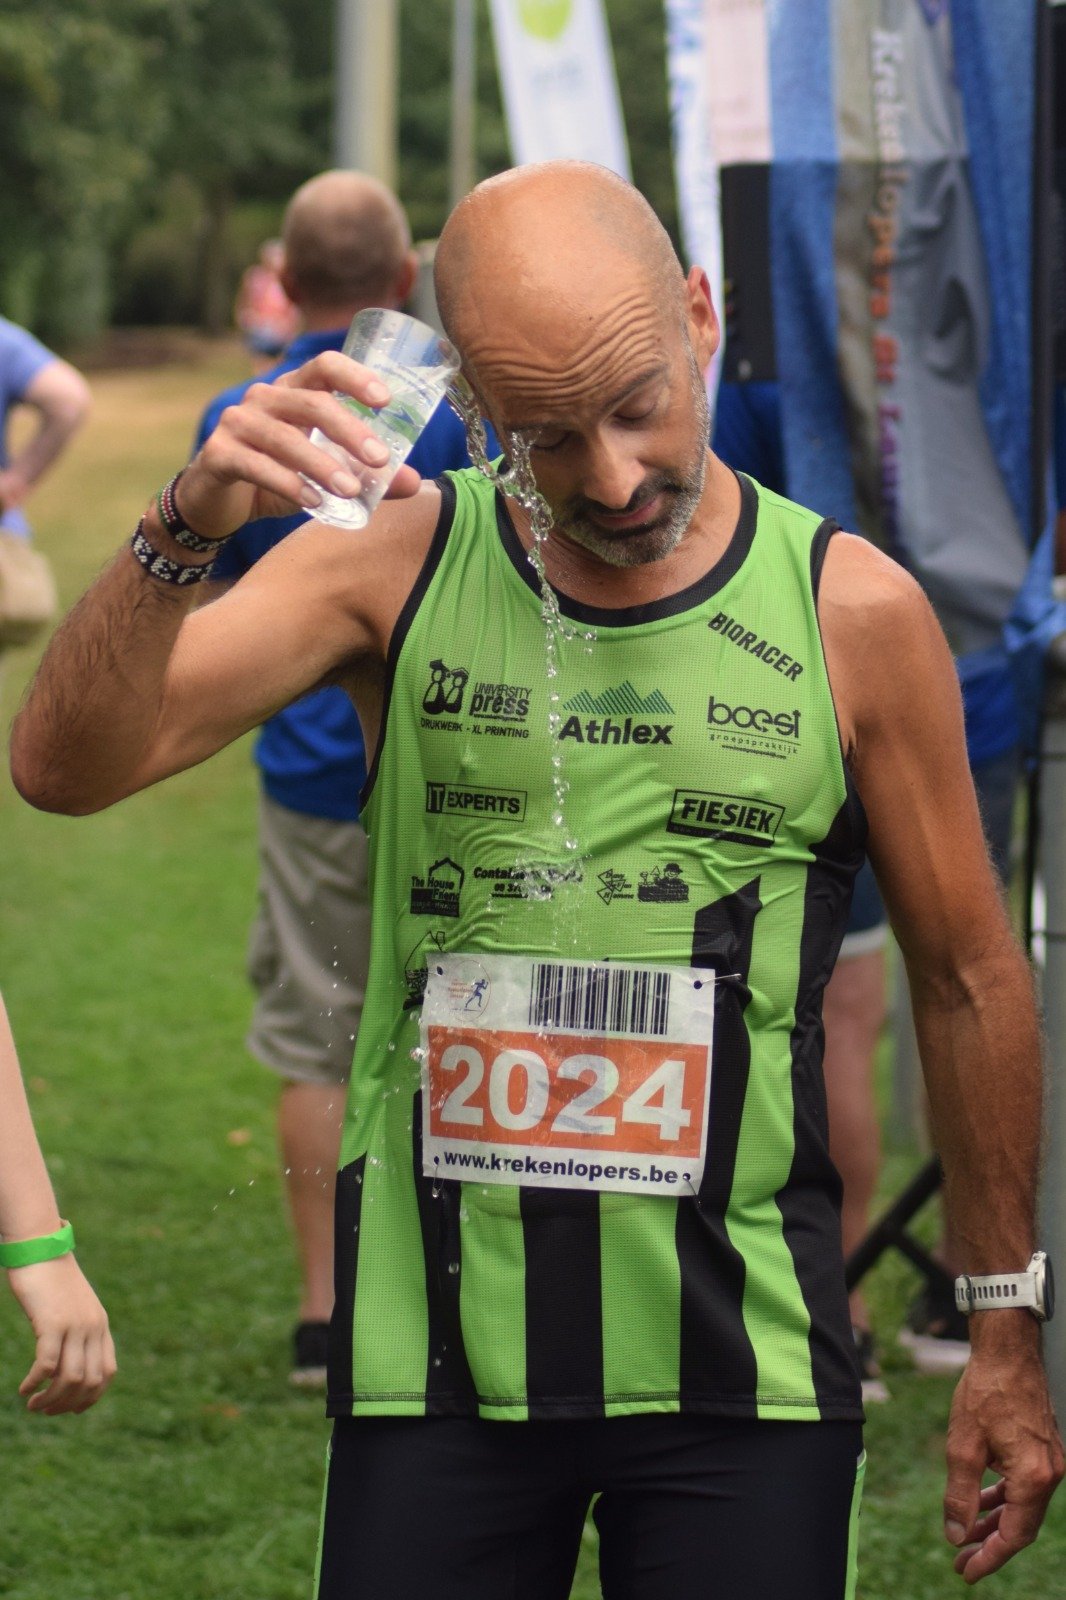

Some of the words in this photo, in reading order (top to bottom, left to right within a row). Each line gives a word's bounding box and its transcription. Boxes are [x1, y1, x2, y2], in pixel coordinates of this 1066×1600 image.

[707, 611, 804, 683] BIORACER
[469, 693, 530, 716] press
[474, 682, 532, 700] UNIVERSITY
[420, 717, 463, 732] DRUKWERK
[471, 724, 482, 735] XL
[484, 725, 530, 739] PRINTING
[558, 716, 674, 745] Athlex
[708, 733, 798, 754] groepspraktijk
[427, 785, 444, 811] IT
[447, 790, 521, 814] EXPERTS
[681, 798, 776, 833] FIESIEK
[411, 875, 425, 888] The
[428, 876, 455, 891] House
[439, 1044, 691, 1141] 2024
[443, 1151, 679, 1184] www.krekenlopers.be
